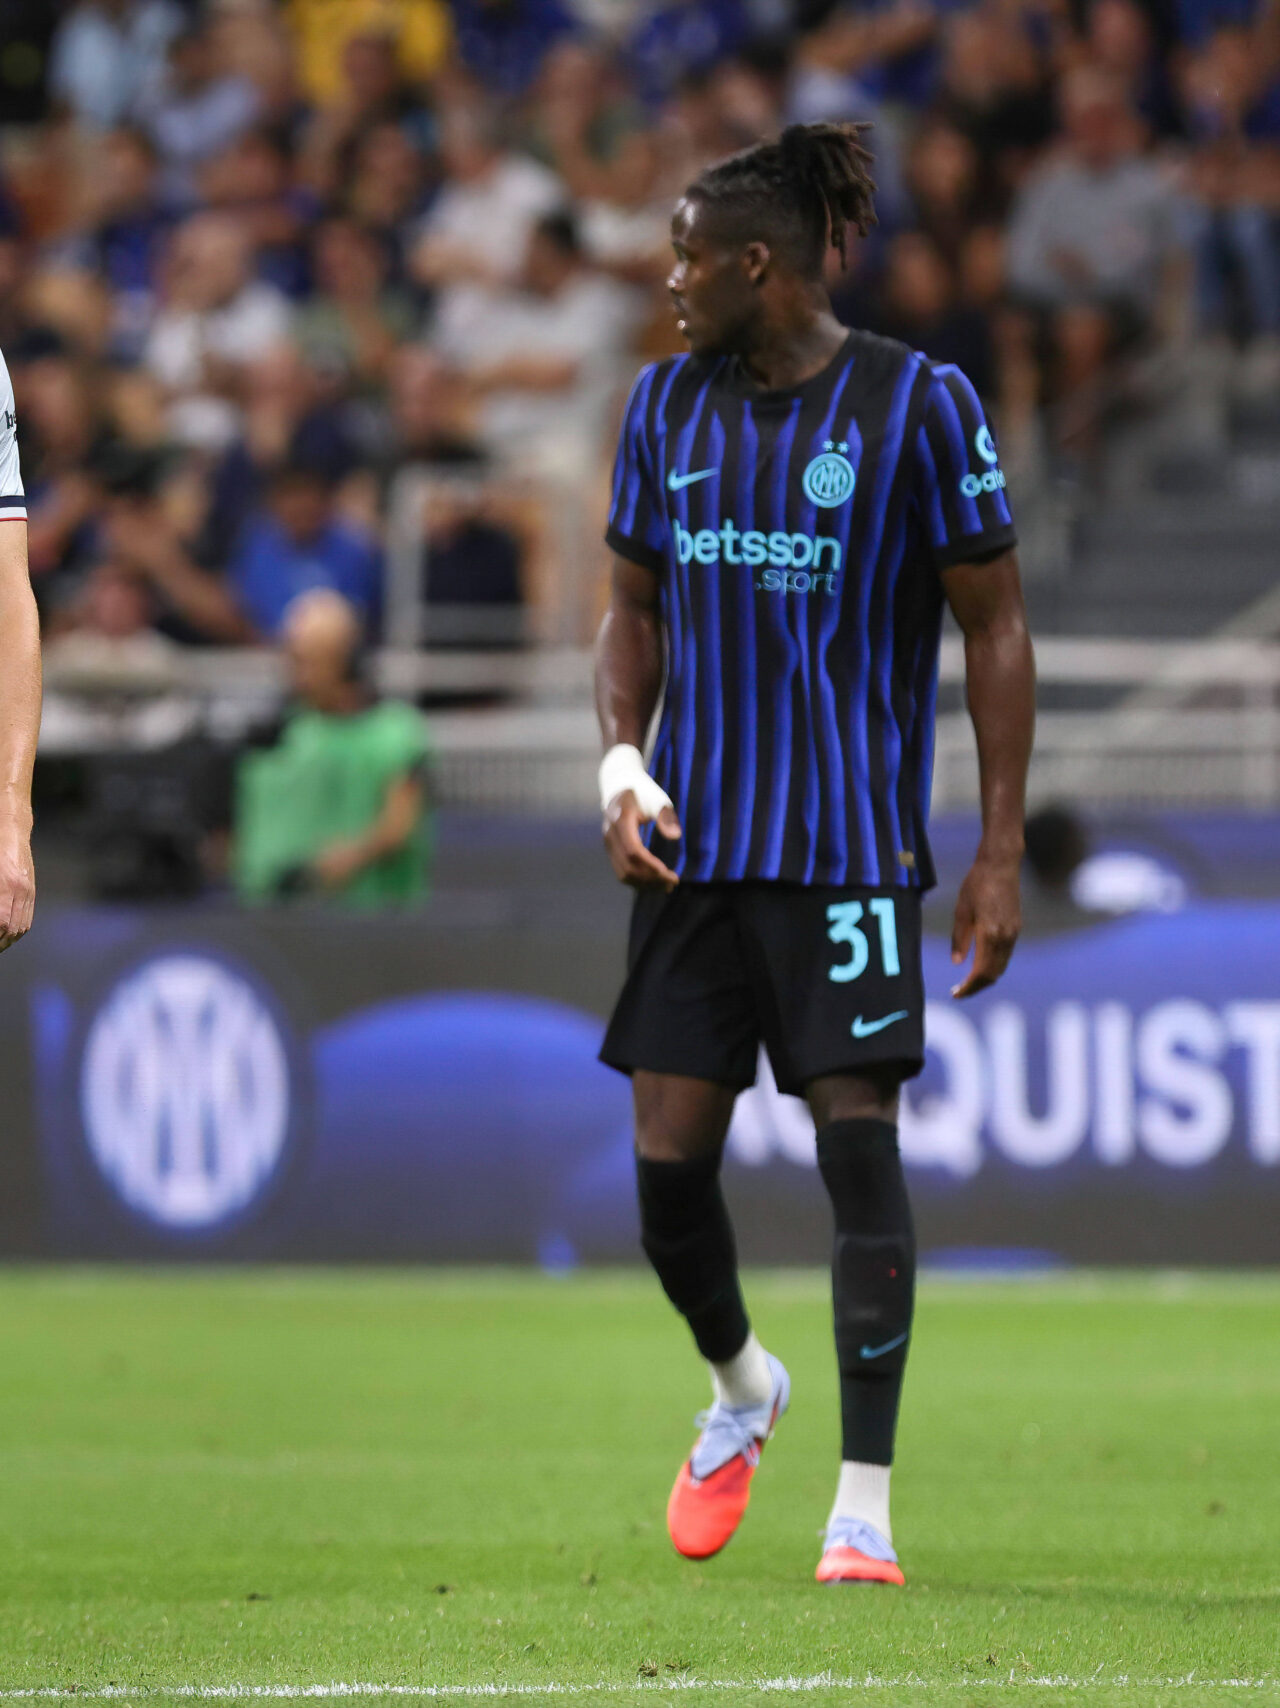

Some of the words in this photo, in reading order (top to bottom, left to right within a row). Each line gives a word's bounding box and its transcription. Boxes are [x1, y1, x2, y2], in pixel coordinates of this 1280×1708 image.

[673, 518, 841, 571] betsson
[828, 898, 901, 982] 31
[722, 998, 1280, 1180] QUIST
